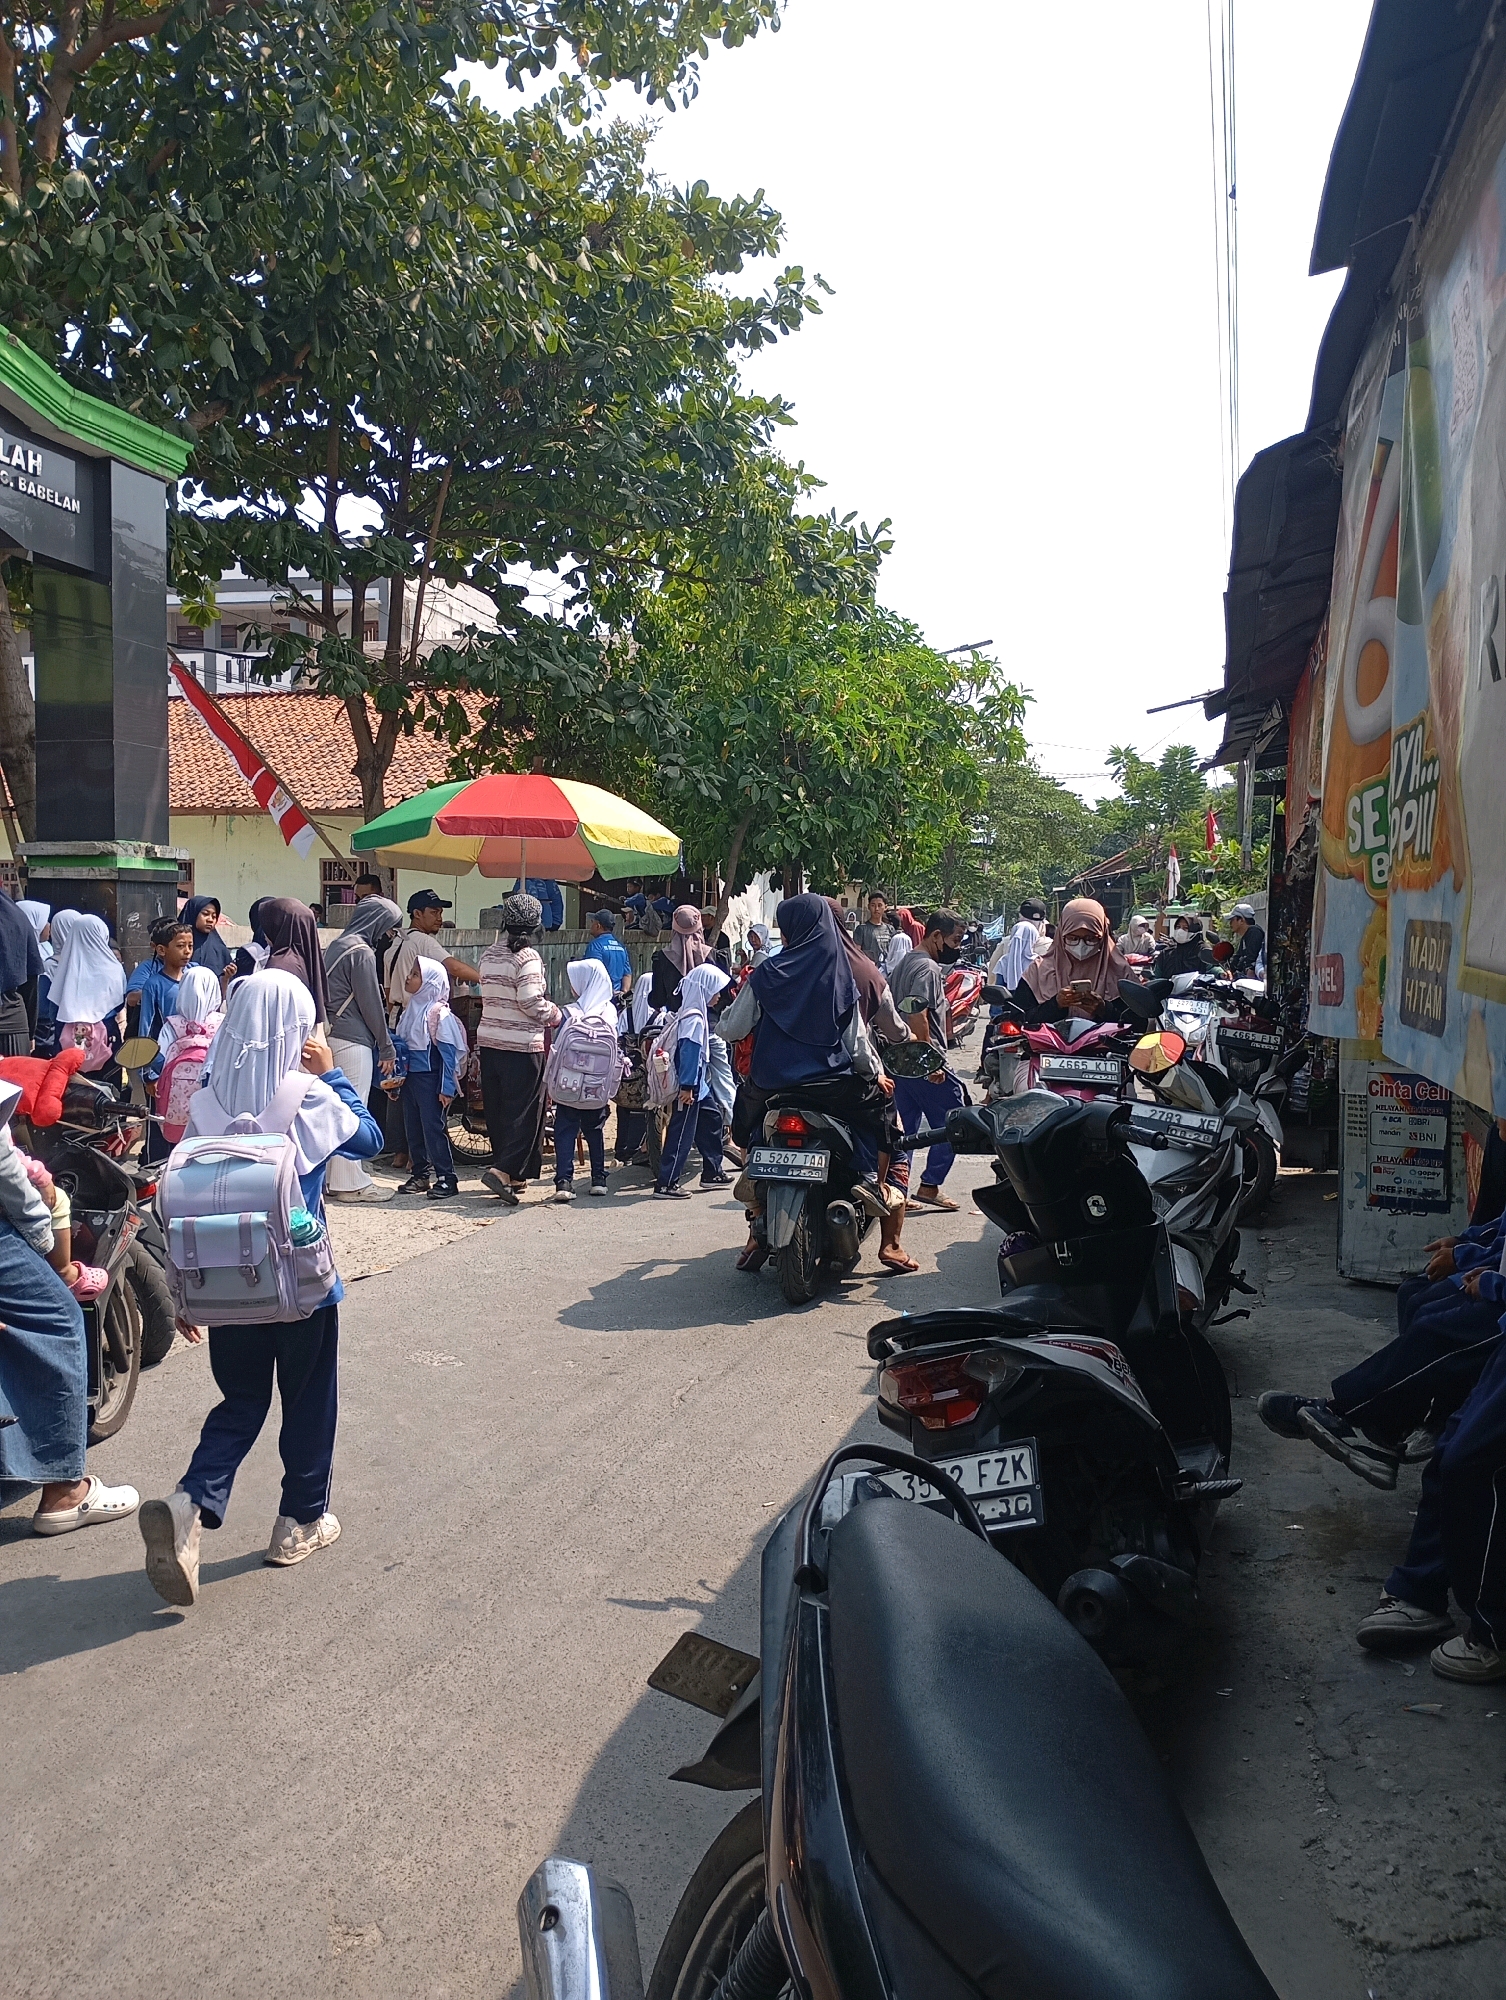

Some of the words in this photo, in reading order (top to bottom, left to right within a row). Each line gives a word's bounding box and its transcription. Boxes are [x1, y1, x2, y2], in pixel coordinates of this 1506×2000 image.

[18, 475, 81, 514] BABELAN
[1409, 936, 1445, 975] MADU
[1404, 977, 1443, 1022] HITAM
[1044, 1058, 1052, 1068] B
[1058, 1059, 1088, 1070] 4665
[1368, 1079, 1412, 1100] Cinta
[1415, 1081, 1450, 1101] Cell
[1149, 1108, 1182, 1124] 2783
[1417, 1118, 1430, 1126] BRI
[1418, 1132, 1437, 1143] BNI
[755, 1152, 762, 1163] B
[768, 1152, 798, 1164] 5267
[803, 1154, 823, 1167] TAA
[1376, 1154, 1412, 1165] MELAYANI
[1417, 1170, 1441, 1178] gopay
[1375, 1184, 1397, 1194] FREE
[902, 1464, 965, 1502] 352
[977, 1452, 1029, 1488] FZK
